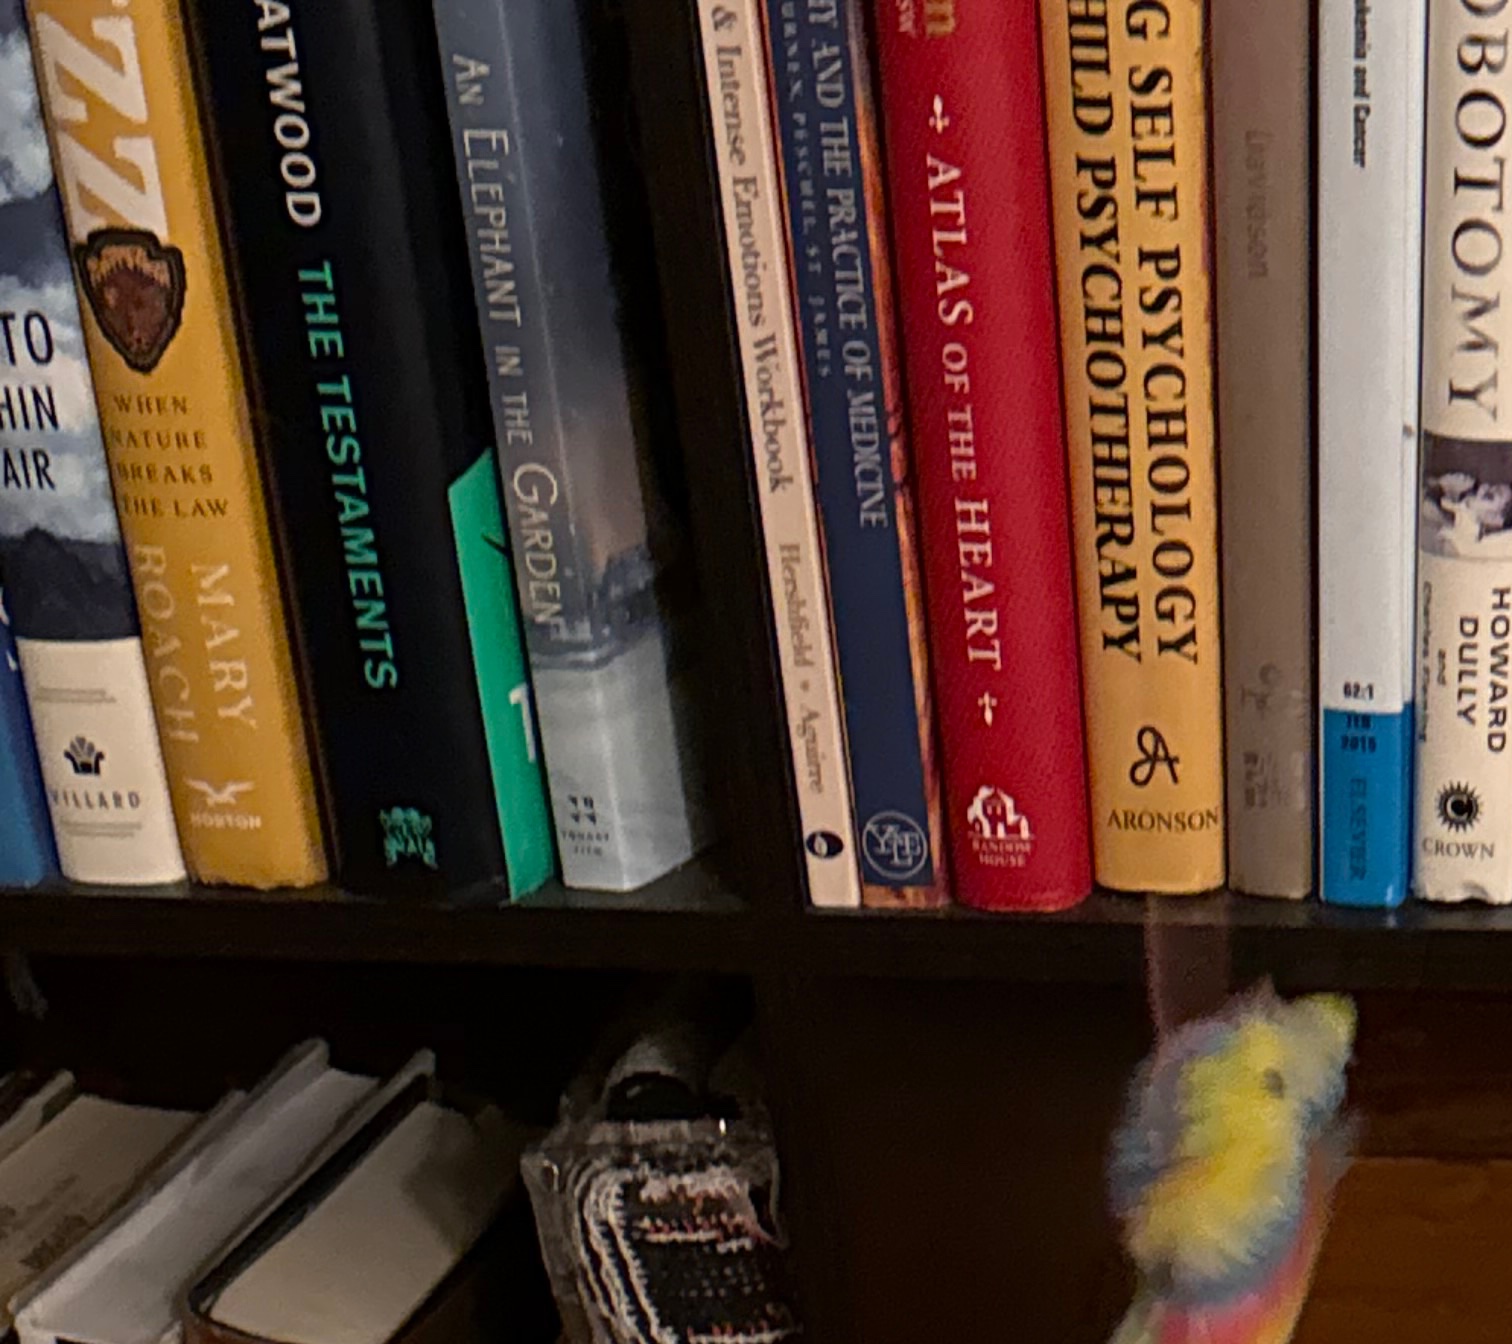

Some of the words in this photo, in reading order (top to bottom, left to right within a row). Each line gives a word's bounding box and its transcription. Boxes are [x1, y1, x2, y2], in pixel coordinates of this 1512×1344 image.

[711, 5, 738, 32] &
[35, 0, 169, 243] ZZ
[256, 0, 322, 227] ATWOOD
[716, 43, 747, 168] Intense
[811, 38, 847, 109] AND
[818, 116, 851, 177] THE
[1127, 65, 1179, 222] SELF
[462, 127, 522, 328] ELEPHANT
[731, 174, 766, 329] Emotions
[826, 187, 868, 332] PRACTICE
[925, 152, 974, 328] ATLAS
[298, 259, 345, 360] THE
[841, 339, 873, 382] OF
[113, 395, 188, 416] WHEN
[502, 390, 534, 447] THE
[751, 330, 794, 494] Workbook
[940, 341, 970, 395] OF
[1074, 155, 1142, 664] PSYCHOTHERAPY
[2, 450, 55, 490] AIR
[109, 429, 207, 451] NATURE
[115, 462, 214, 484] BREAKS
[846, 387, 889, 530] MEDICINE
[947, 406, 977, 483] THE
[1137, 243, 1199, 665] PSYCHOLOGY
[121, 497, 165, 517] THE
[174, 498, 229, 519] LAW
[316, 374, 398, 691] TESTAMENTS
[513, 461, 566, 640] GARDEN
[954, 497, 1001, 673] HEART
[134, 544, 200, 746] ROACH
[191, 560, 257, 729] MARY
[1456, 615, 1480, 727] DULLY
[1487, 585, 1512, 754] HOWARD
[51, 789, 142, 811] VILLARD
[796, 706, 825, 795] Aguirre
[190, 811, 262, 831] NORTON
[971, 838, 1033, 854] RANDOM
[979, 853, 1027, 868] HOUSE
[1106, 805, 1220, 834] ARONSON
[1350, 777, 1370, 881] ELSEVIER
[1421, 837, 1496, 860] CROWN
